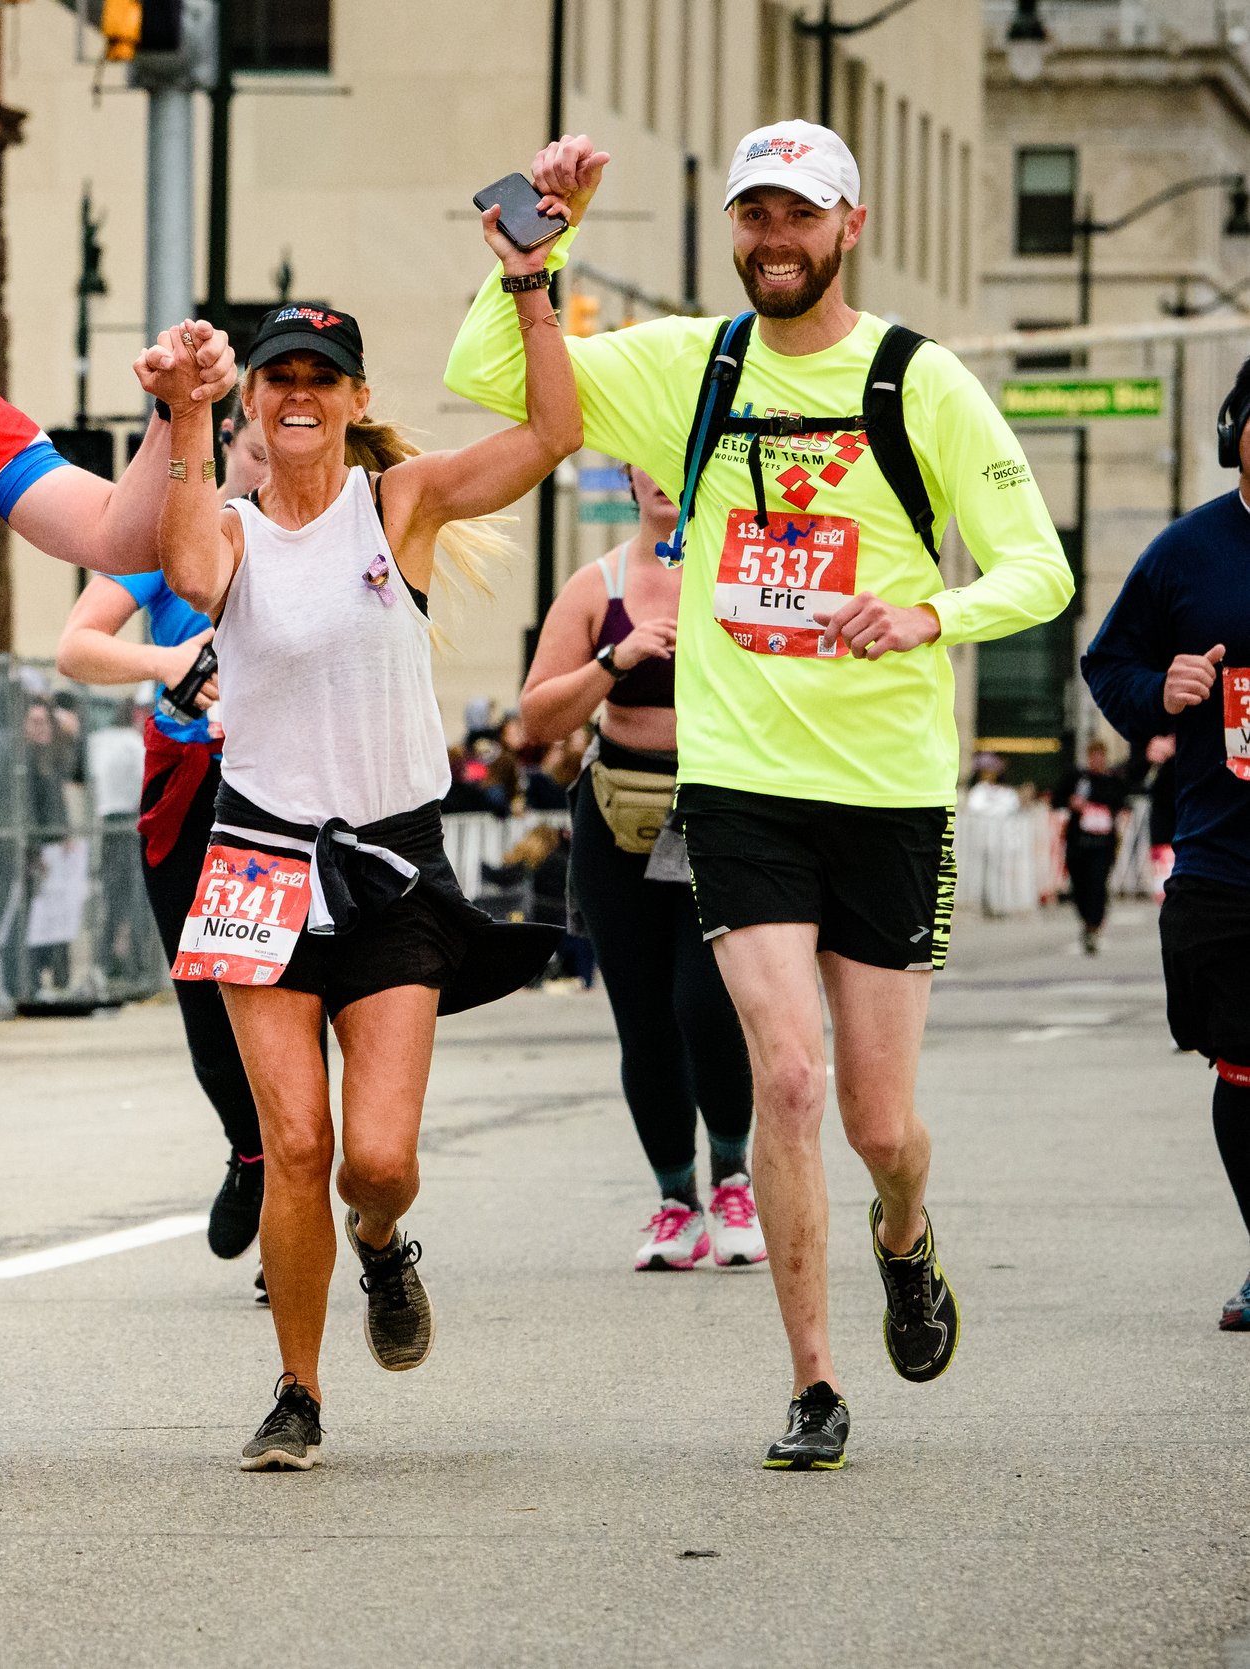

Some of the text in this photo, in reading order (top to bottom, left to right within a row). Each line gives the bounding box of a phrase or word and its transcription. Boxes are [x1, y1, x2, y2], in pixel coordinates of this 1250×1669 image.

[782, 451, 825, 466] TEAM
[991, 459, 1015, 470] Military
[737, 544, 834, 590] 5337
[759, 587, 806, 611] Eric
[733, 605, 738, 616] J
[733, 631, 753, 647] 5337
[1240, 744, 1248, 753] H
[201, 878, 286, 926] 5341
[203, 917, 272, 943] Nicole
[187, 962, 203, 976] 5341
